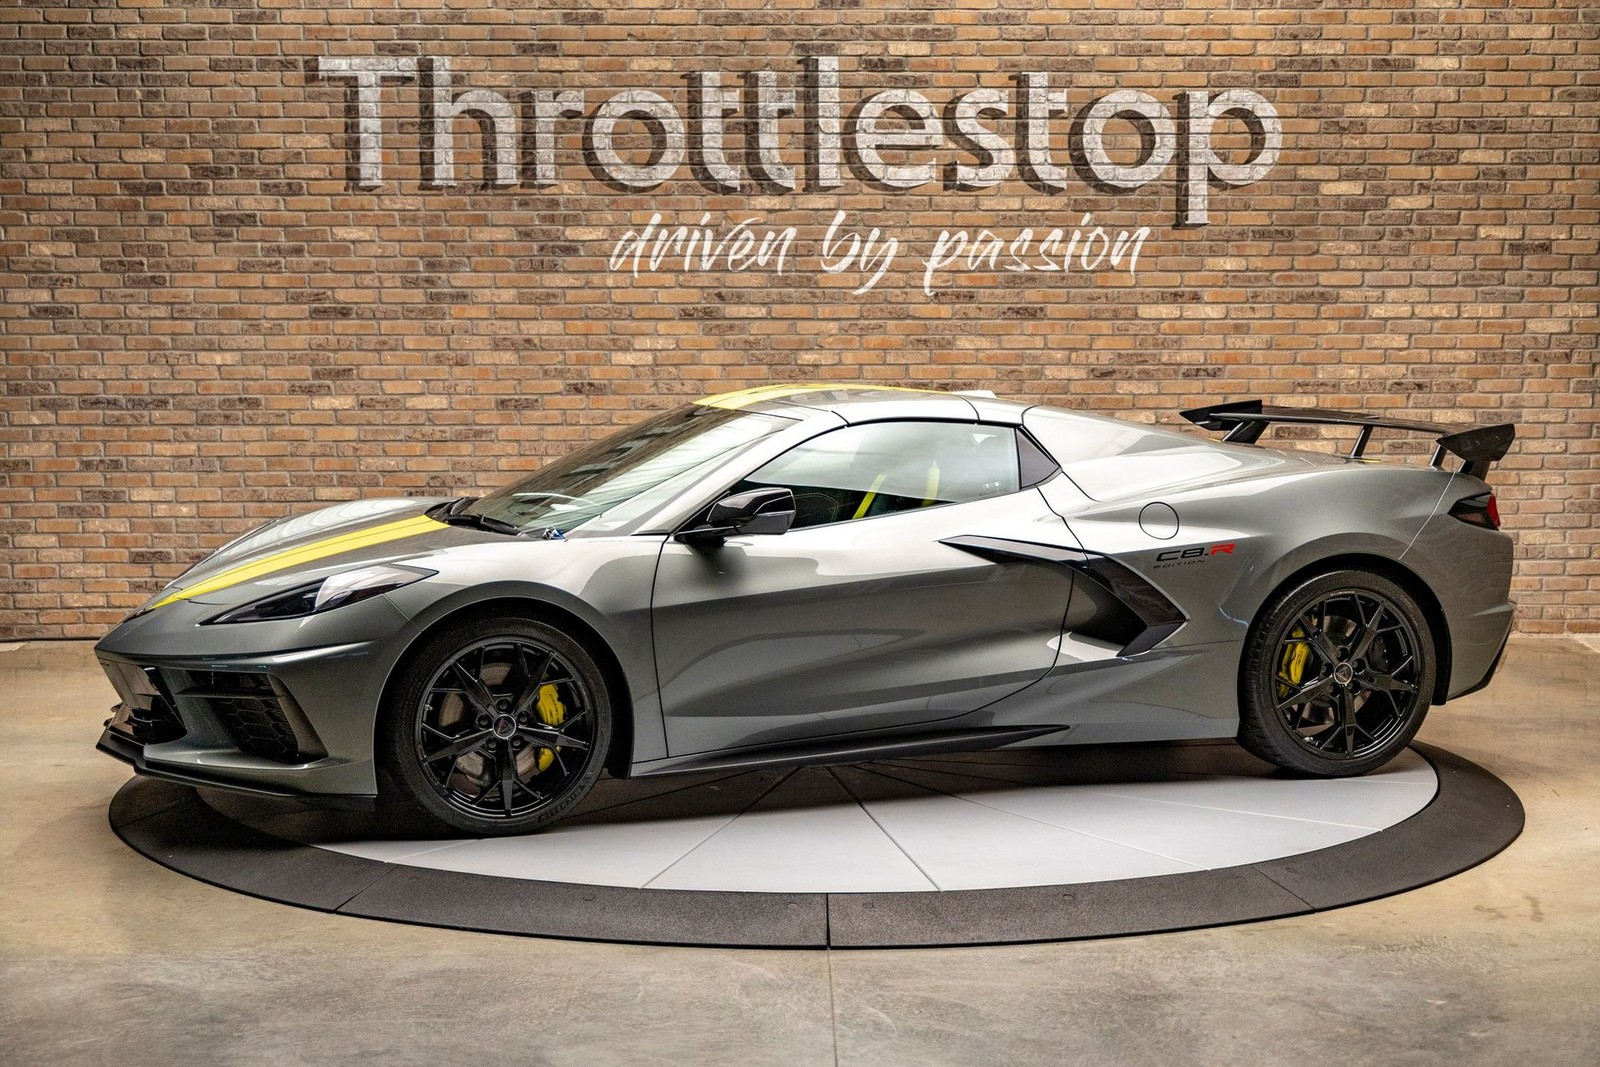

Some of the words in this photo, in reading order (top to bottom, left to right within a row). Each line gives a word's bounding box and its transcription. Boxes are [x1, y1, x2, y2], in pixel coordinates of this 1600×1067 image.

[308, 55, 1283, 227] Throttlestop
[609, 212, 798, 278] driven
[820, 209, 899, 296] by
[921, 212, 1152, 297] passion
[1153, 559, 1206, 569] EDITION
[1156, 543, 1236, 561] C8.R
